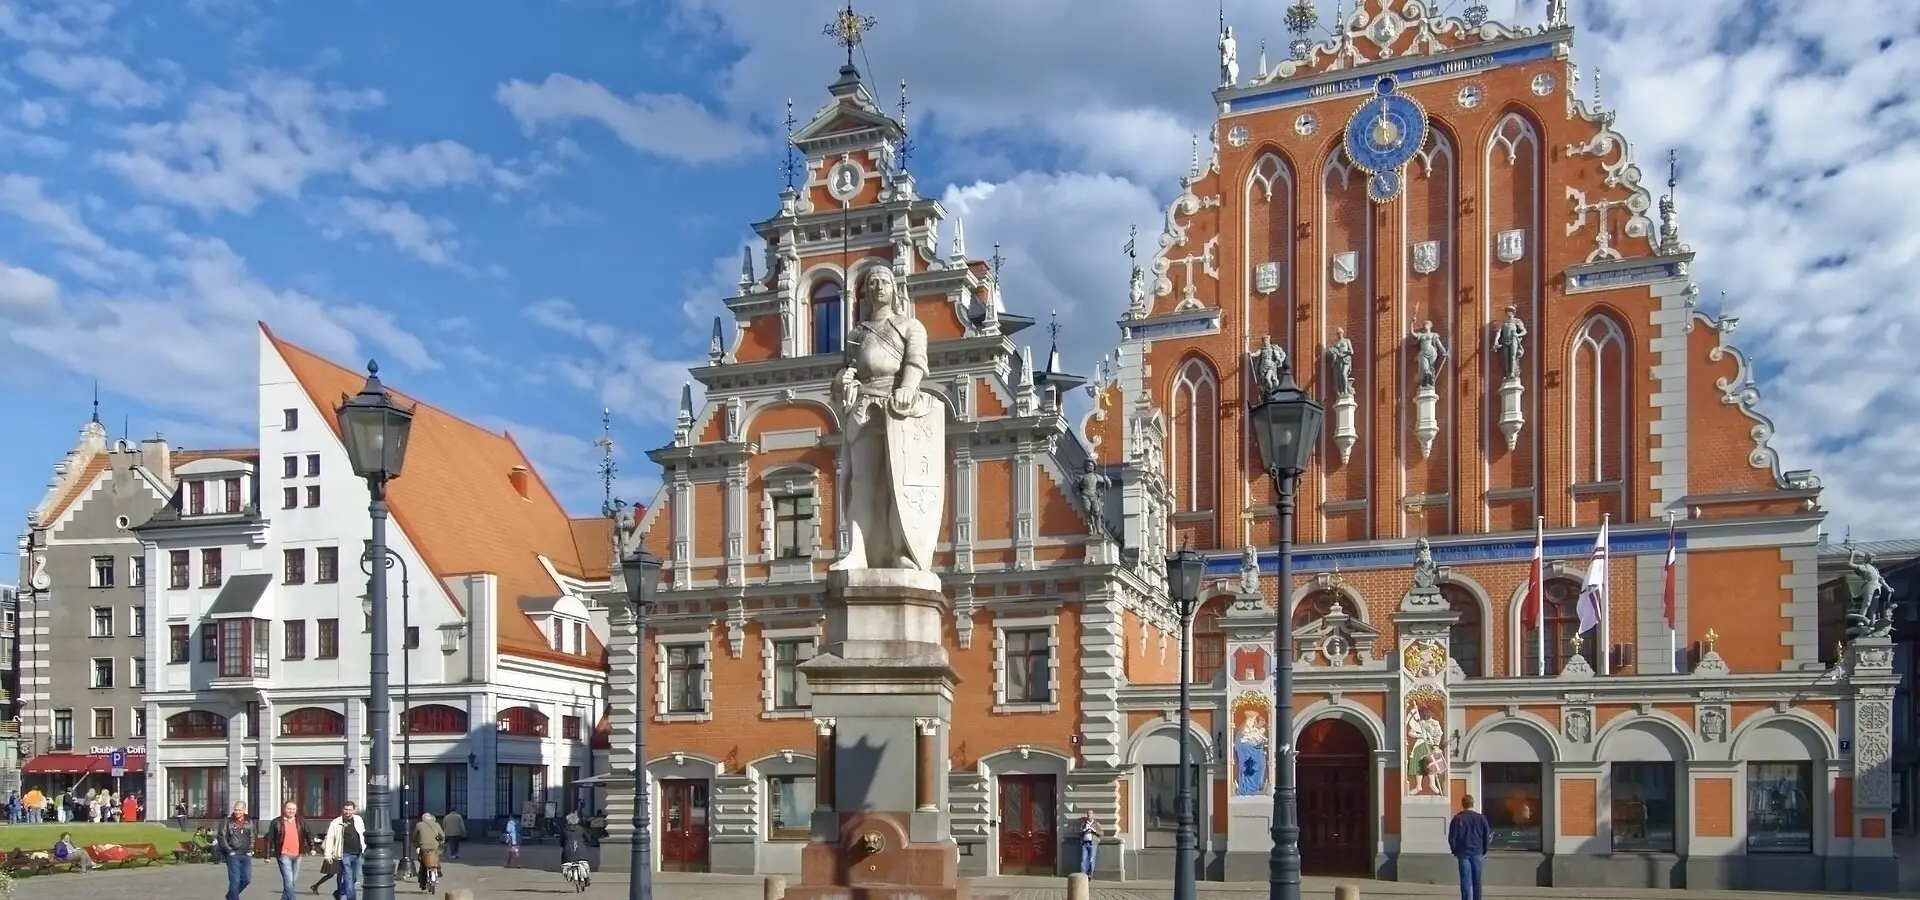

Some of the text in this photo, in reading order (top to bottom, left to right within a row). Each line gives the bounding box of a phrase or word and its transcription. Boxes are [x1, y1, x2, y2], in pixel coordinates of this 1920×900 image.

[1438, 60, 1467, 76] ANNO
[91, 745, 117, 754] Double
[113, 753, 121, 765] P
